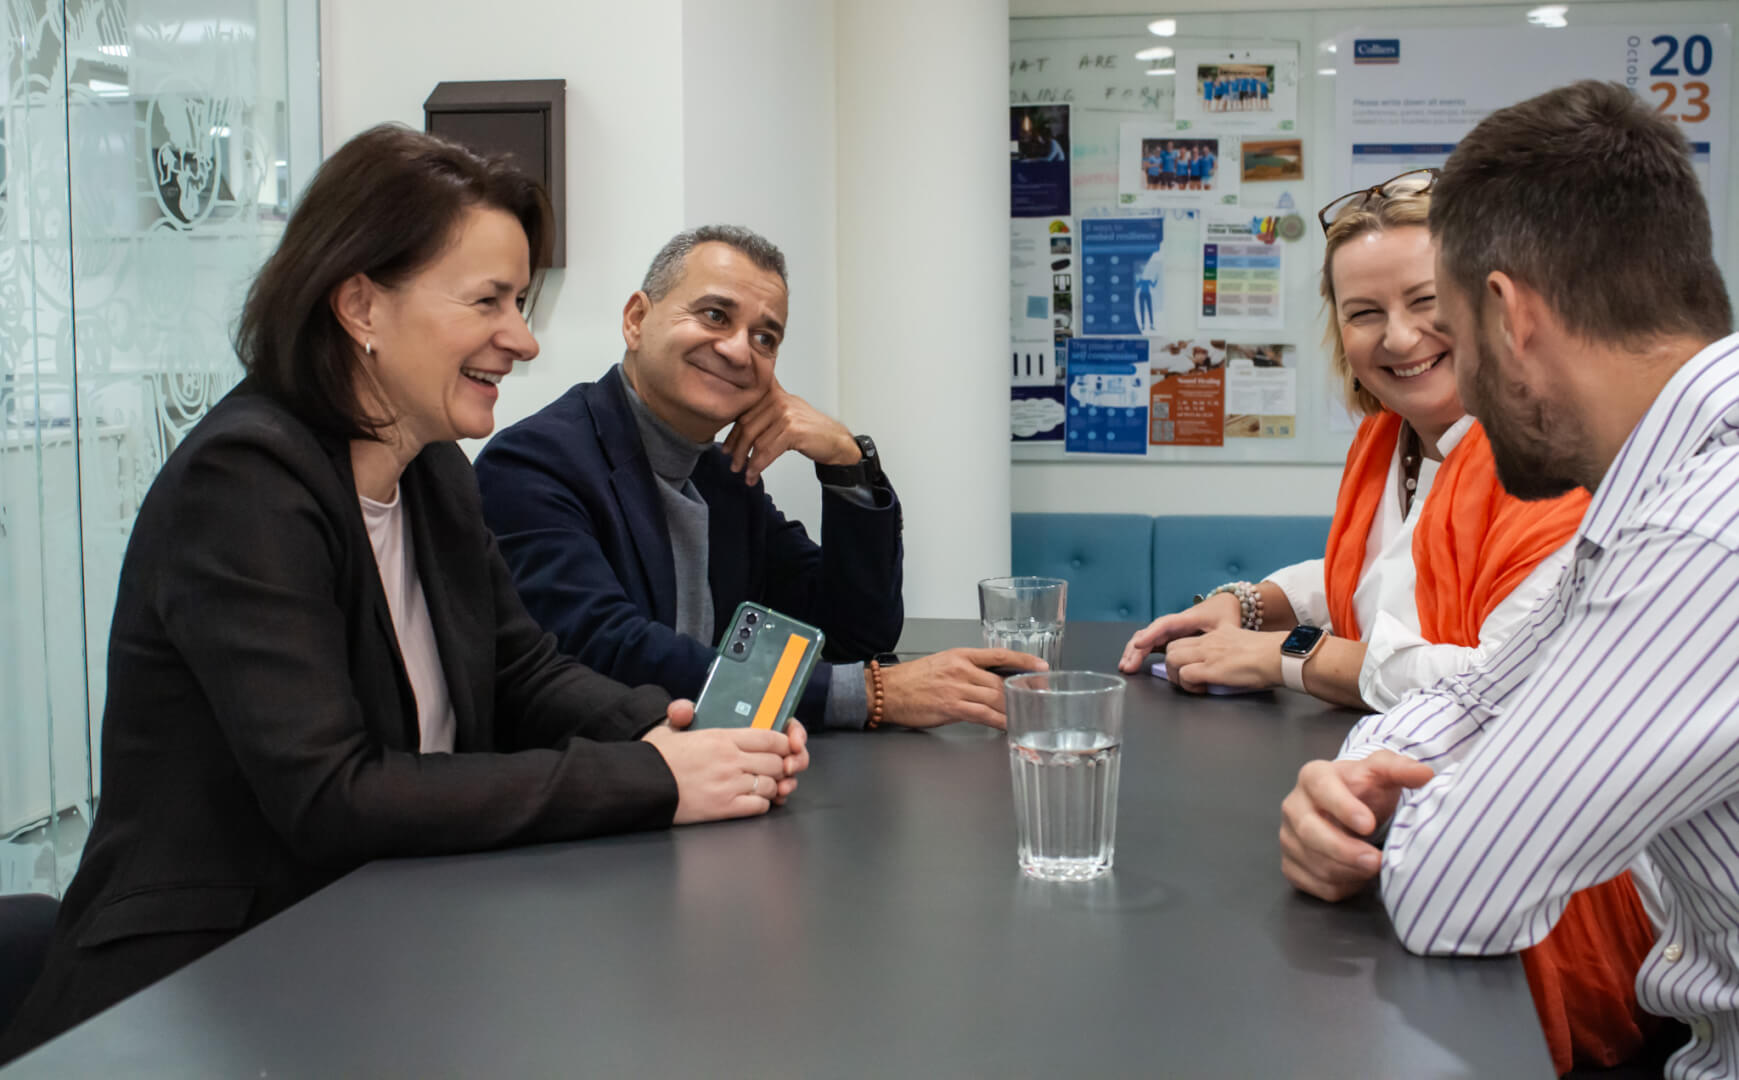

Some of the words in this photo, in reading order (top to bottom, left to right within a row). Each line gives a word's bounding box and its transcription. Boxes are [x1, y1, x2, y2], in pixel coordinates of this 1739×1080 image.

[1078, 54, 1117, 71] ARE
[1357, 43, 1396, 55] Colliers
[1626, 35, 1641, 89] Octob
[1649, 34, 1713, 77] 20
[1649, 81, 1711, 123] 23
